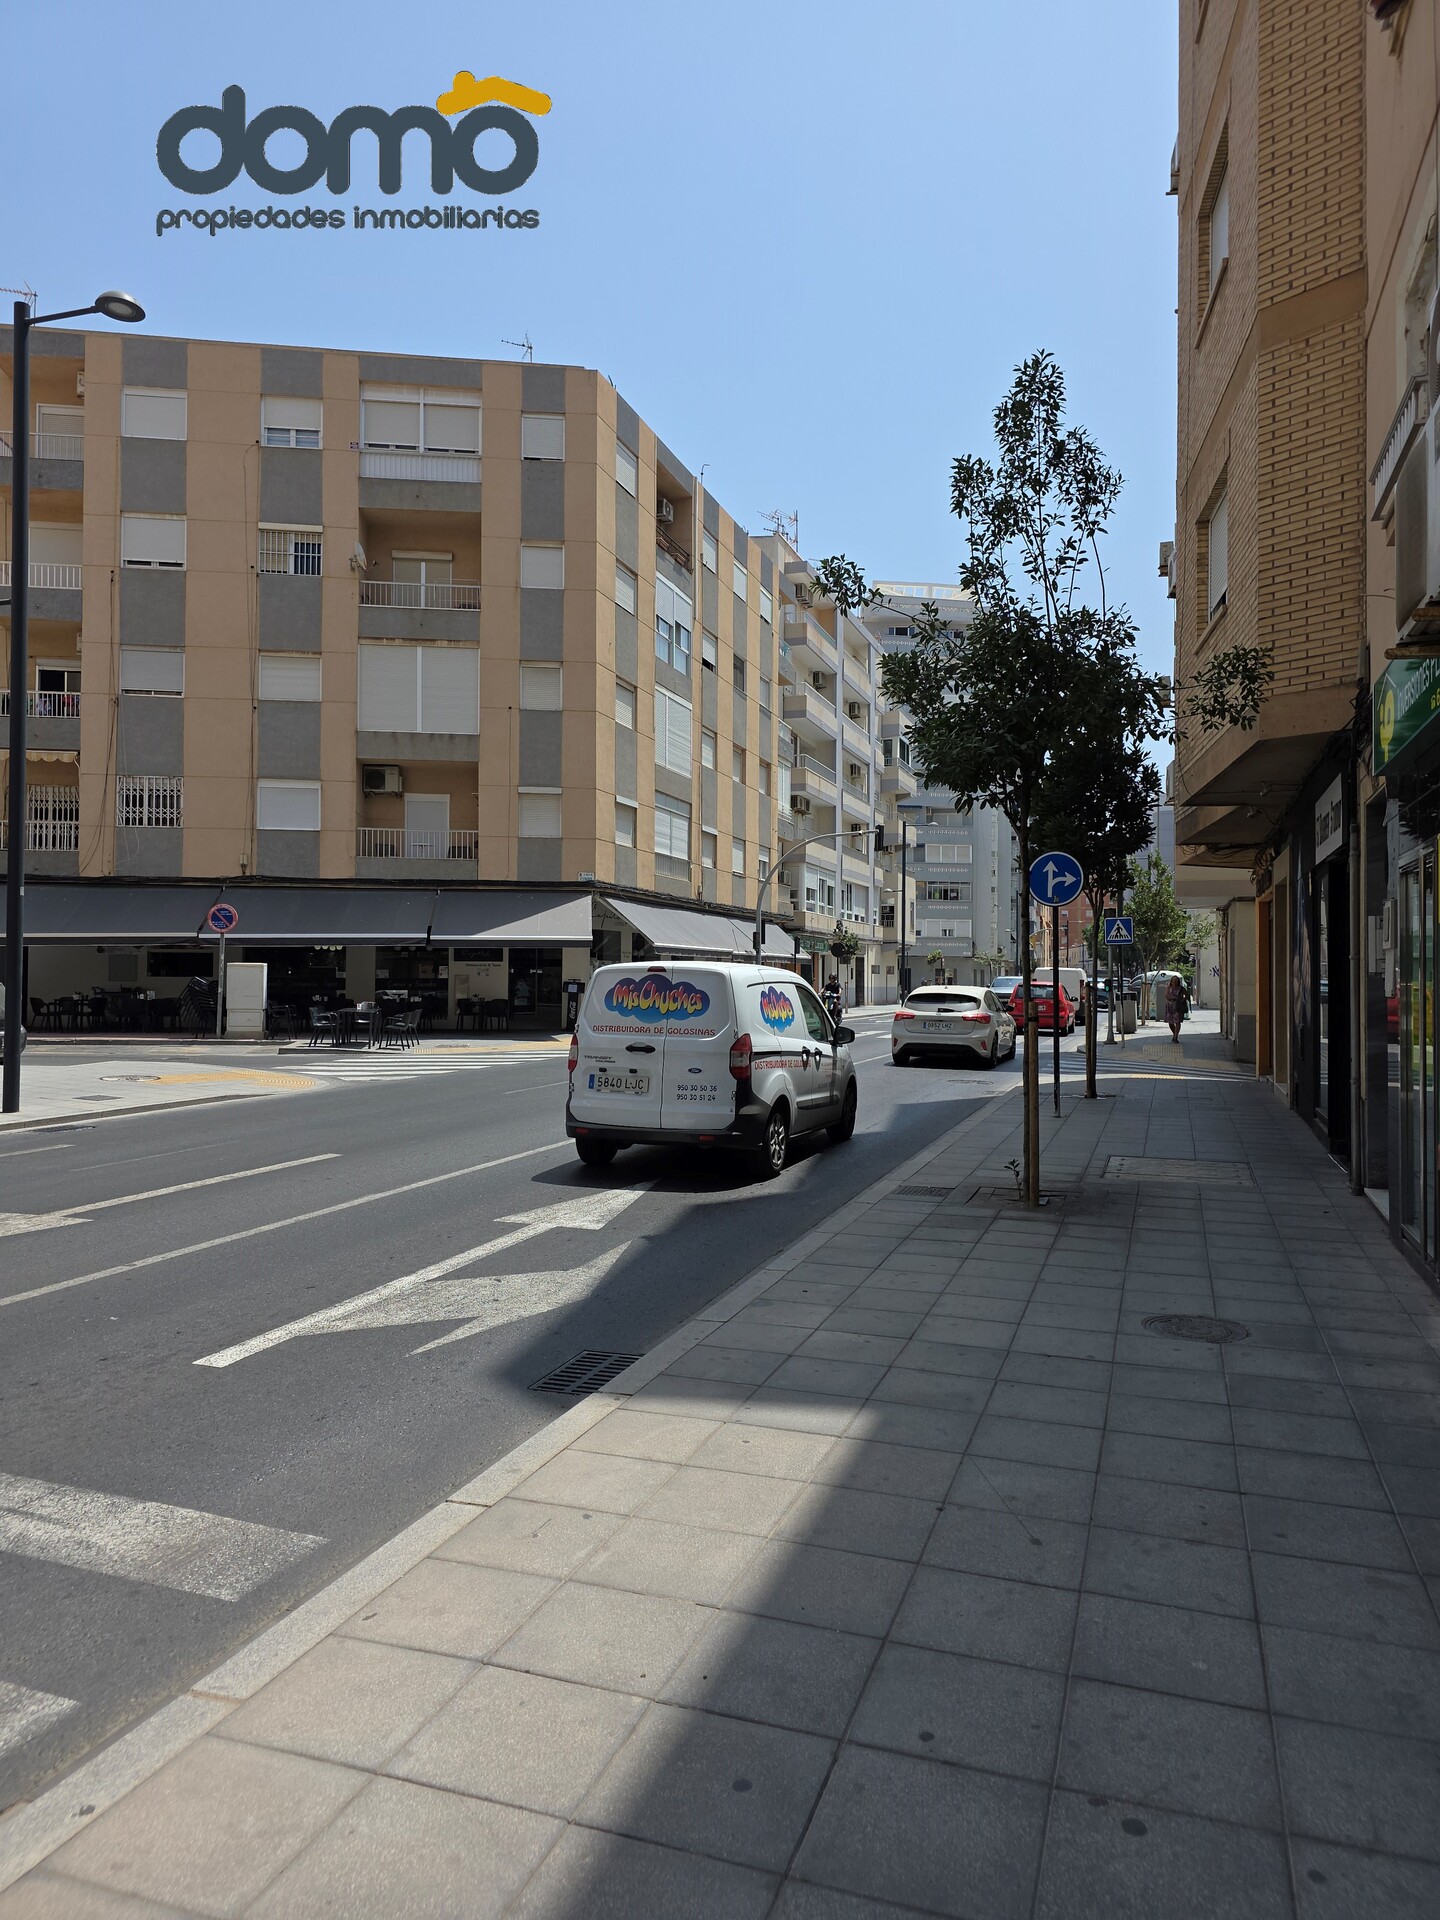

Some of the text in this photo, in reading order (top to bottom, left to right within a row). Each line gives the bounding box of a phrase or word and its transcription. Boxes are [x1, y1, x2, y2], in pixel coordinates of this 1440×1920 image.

[592, 1024, 716, 1036] DISTRIBUIDORA DE GOLOSINAS
[597, 1077, 622, 1089] 5840
[689, 1093, 698, 1101] 30
